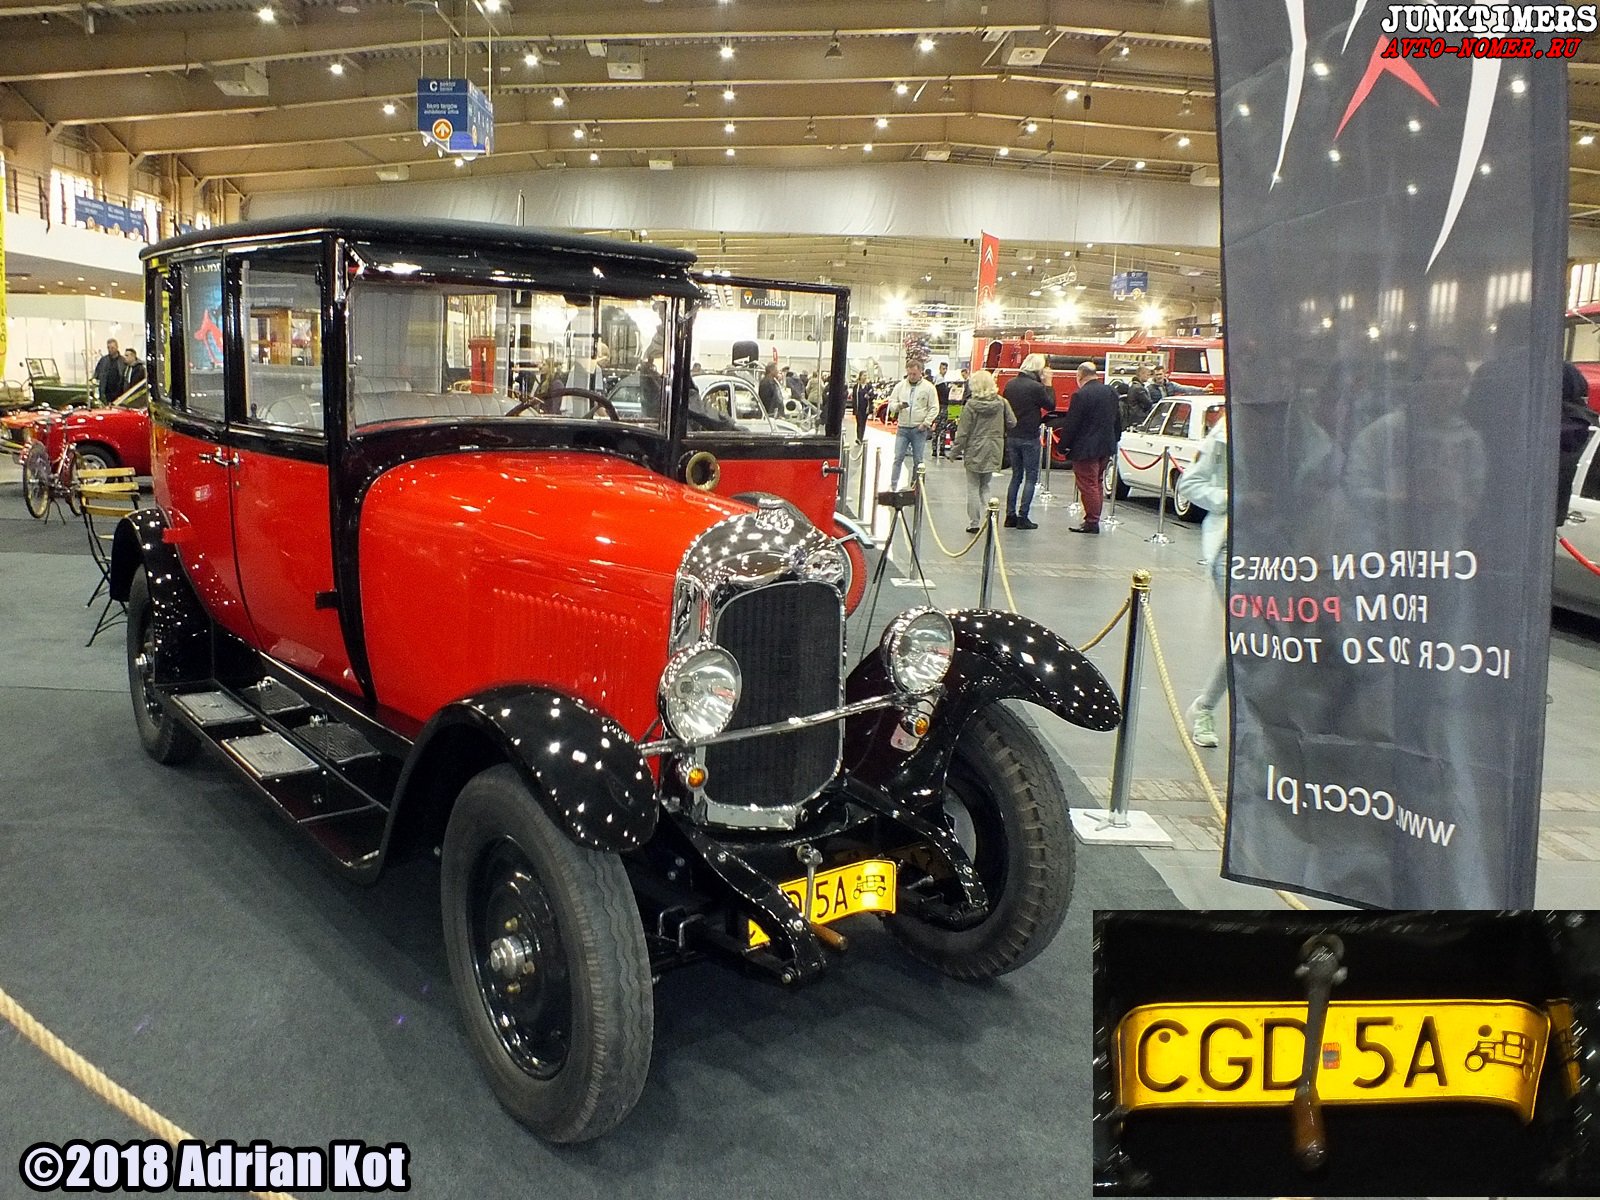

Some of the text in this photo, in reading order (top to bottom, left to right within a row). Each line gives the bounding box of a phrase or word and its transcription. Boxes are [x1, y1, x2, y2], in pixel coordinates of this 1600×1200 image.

[429, 81, 438, 92] C
[815, 876, 848, 918] 5A
[1137, 1015, 1448, 1093] CGD 5A
